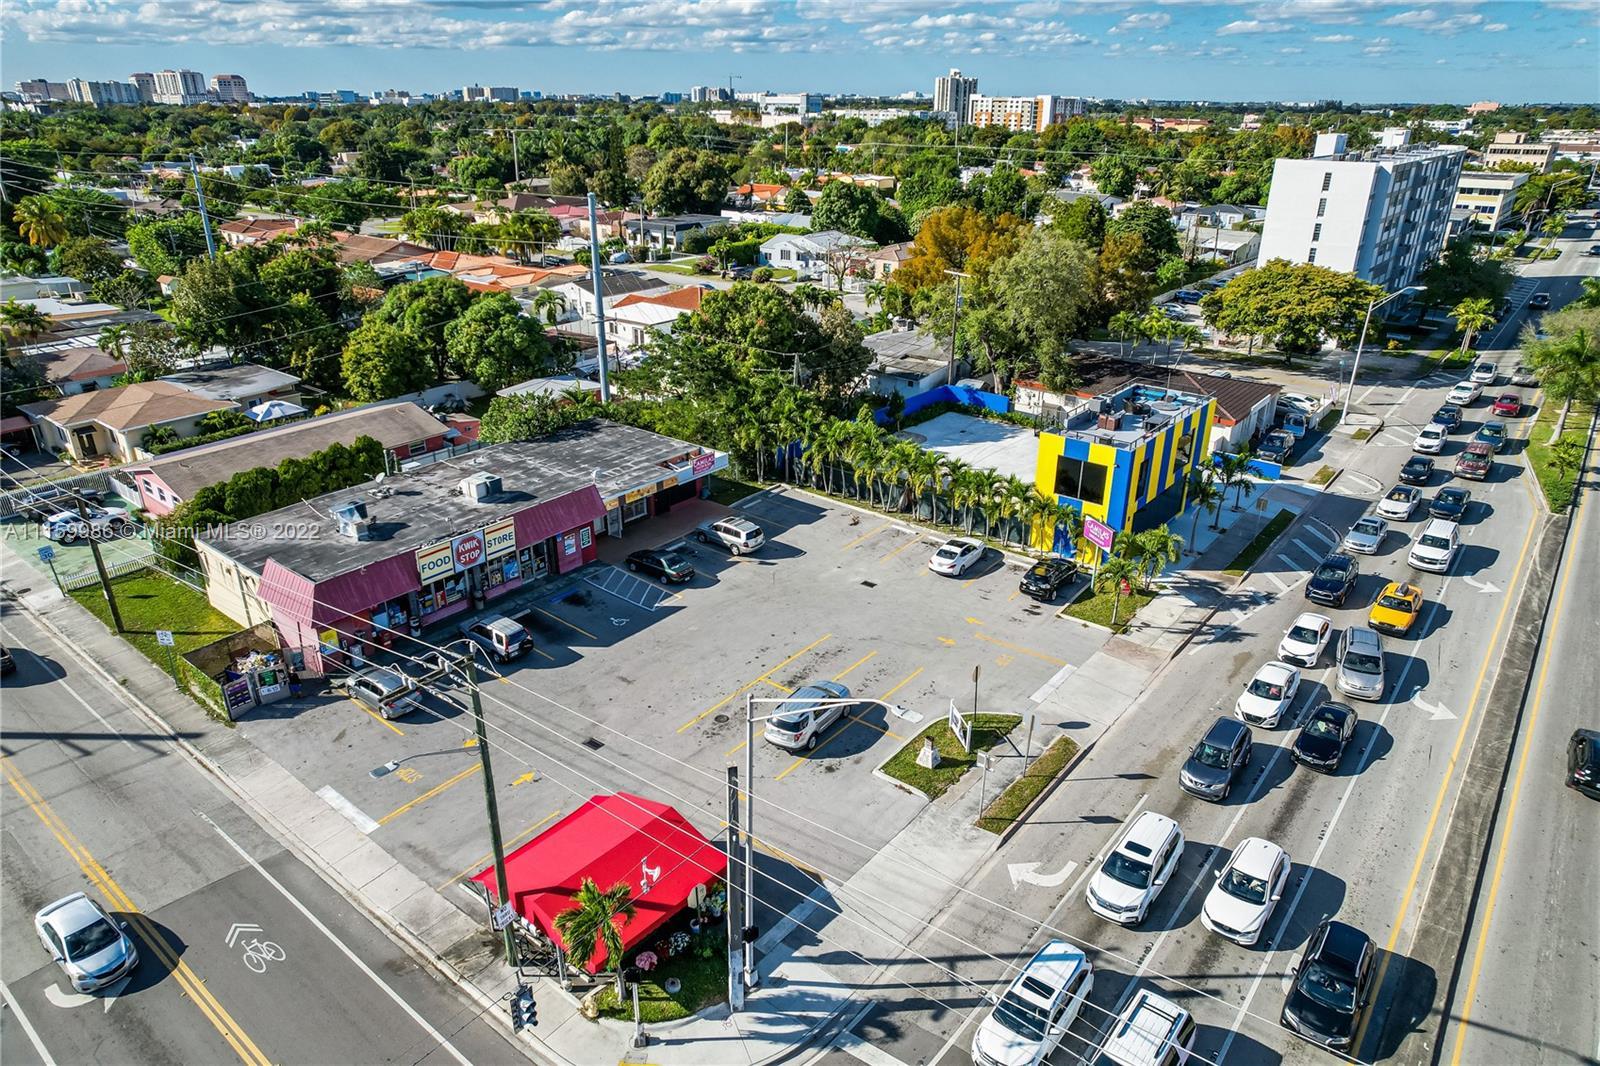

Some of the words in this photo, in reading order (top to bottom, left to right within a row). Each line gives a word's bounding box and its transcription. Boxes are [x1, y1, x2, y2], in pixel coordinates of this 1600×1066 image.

[458, 539, 480, 553] KWIK
[487, 532, 514, 548] STORE
[460, 549, 481, 563] STOP
[421, 556, 451, 573] FOOD
